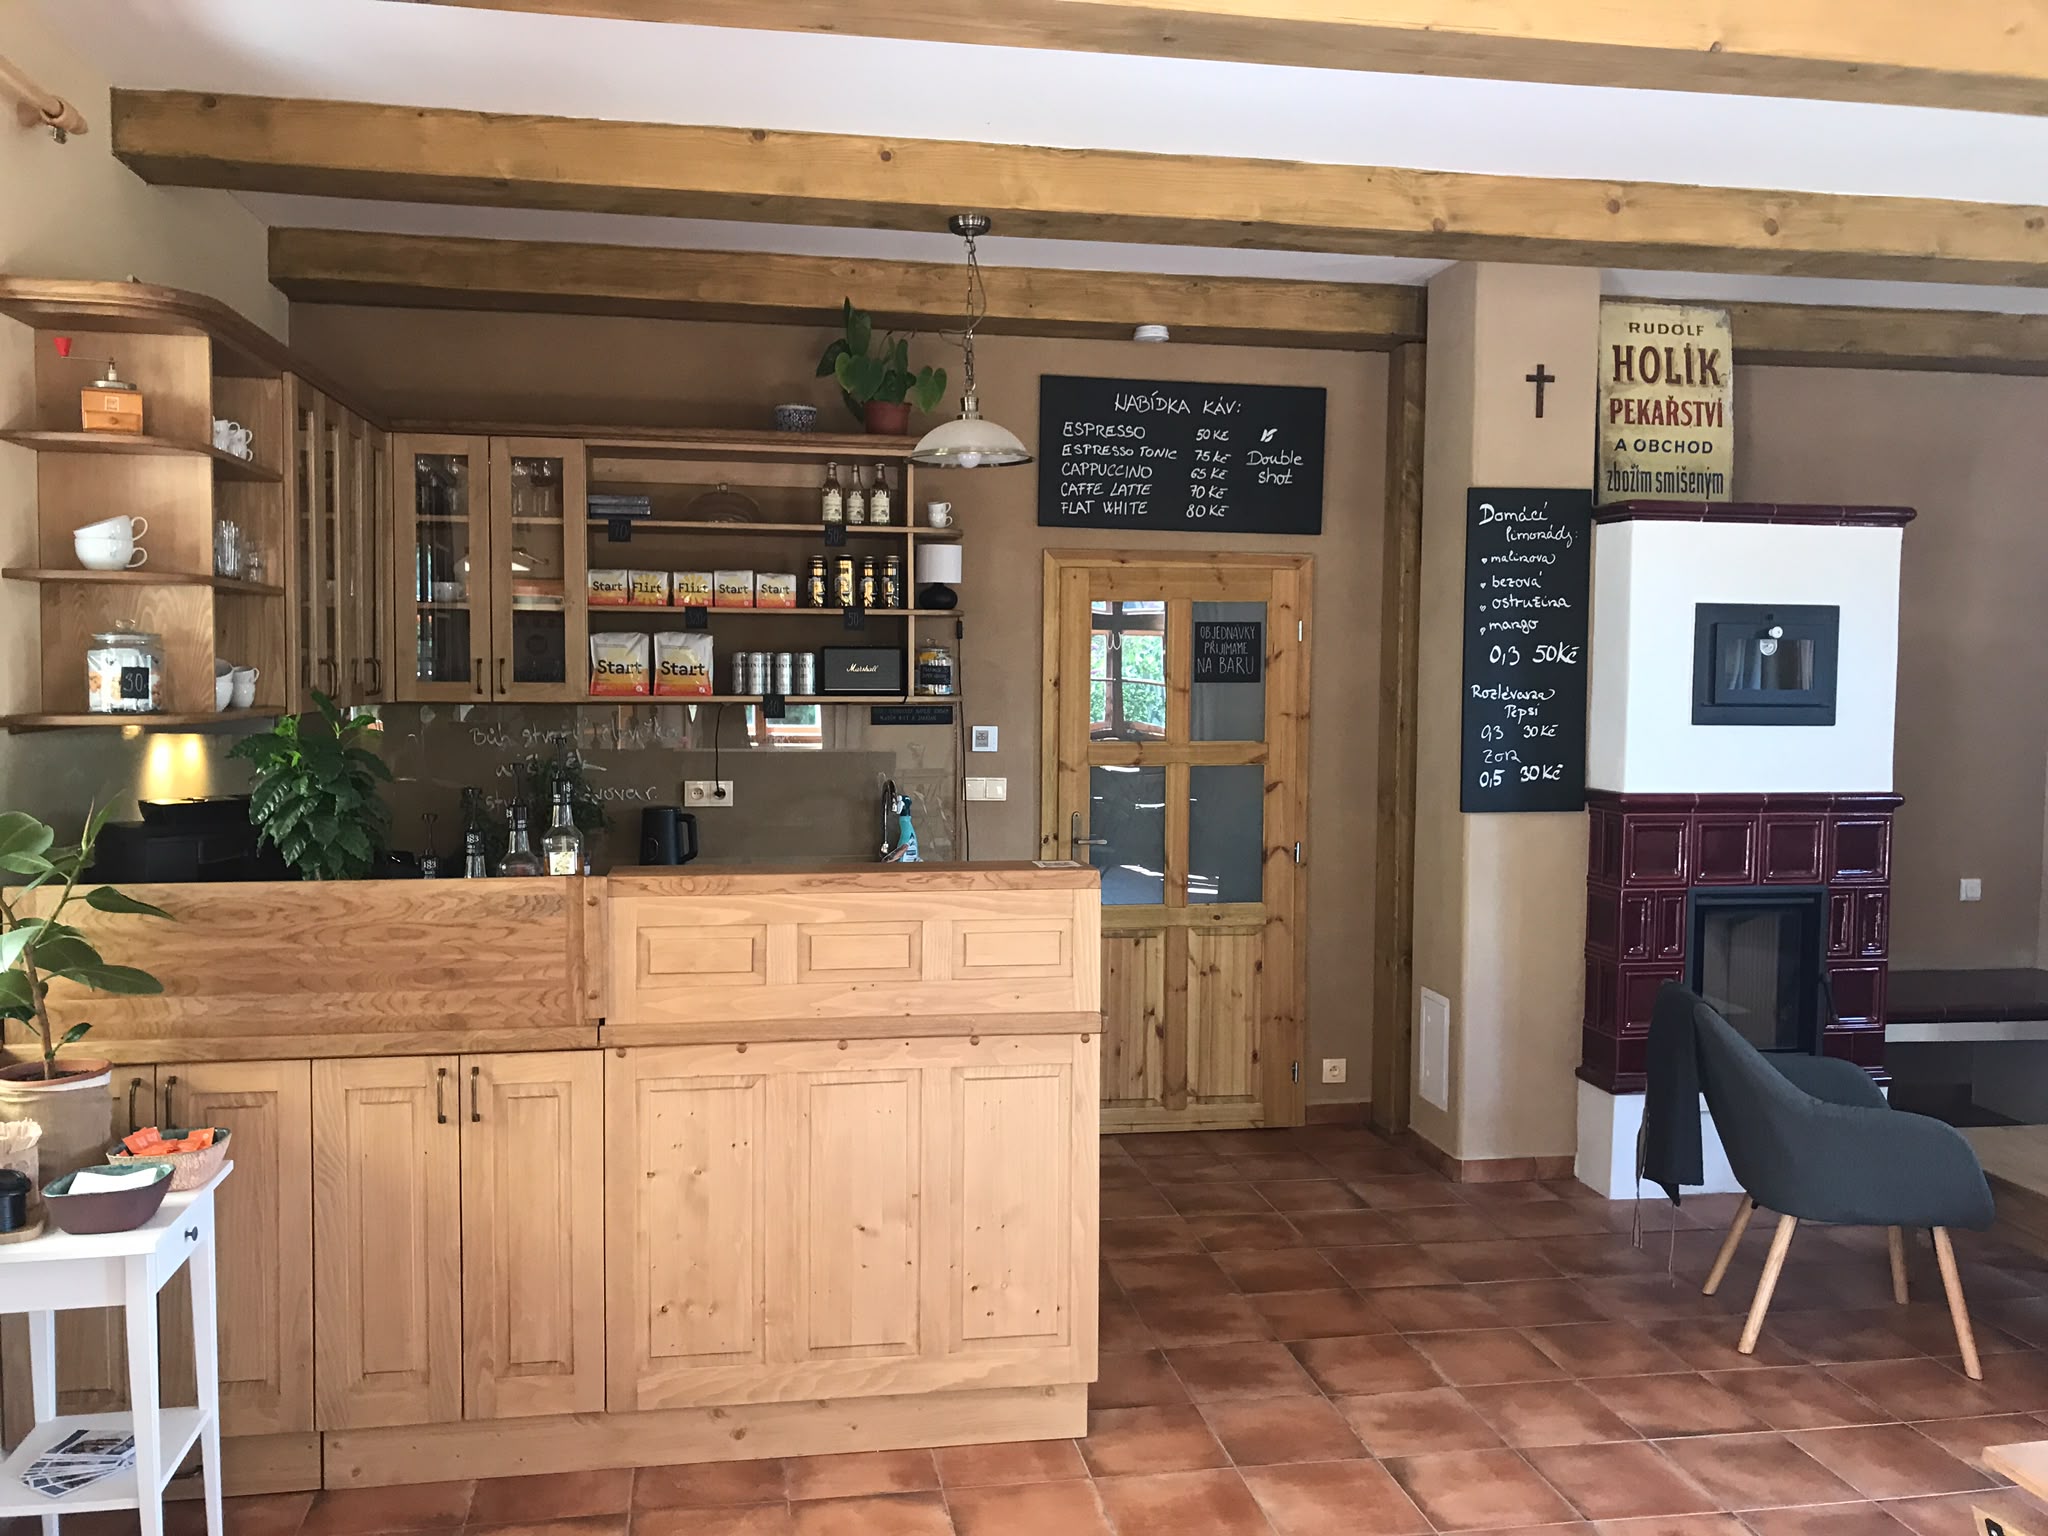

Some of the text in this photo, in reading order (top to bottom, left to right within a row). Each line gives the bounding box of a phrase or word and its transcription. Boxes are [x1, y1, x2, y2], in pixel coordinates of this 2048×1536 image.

[1629, 322, 1704, 336] RUDOLF
[1612, 343, 1721, 385] HOLÍK
[1114, 390, 1242, 416] NABÍDKA KÁV:
[1610, 395, 1723, 427] PEKAŘSTVÍ
[1062, 421, 1146, 440] ESPRESSO
[1195, 428, 1211, 442] 50
[1061, 443, 1134, 457] ESPRESSO
[1139, 445, 1178, 460] TONIC
[1194, 449, 1211, 462] 75
[1614, 438, 1713, 454] A OBCHOD
[1246, 449, 1304, 468] Double
[1061, 461, 1153, 479] CAPPUCCINO
[1190, 467, 1207, 480] 65
[1258, 468, 1293, 486] shot
[1607, 462, 1724, 500] zbožím smíšeným
[1060, 482, 1105, 497] CAFFE
[1109, 482, 1152, 497] LATTE
[1189, 484, 1206, 499] 70
[1060, 500, 1096, 515] FLAT
[1102, 500, 1148, 516] WHITE
[1185, 504, 1207, 519] 80
[1478, 501, 1548, 526] Domácí
[592, 580, 623, 592] Start
[633, 582, 662, 594] Flirt
[678, 582, 709, 594] Flirt
[1491, 570, 1543, 589] bezová
[719, 583, 749, 595] Start
[761, 583, 790, 595] Start
[1491, 593, 1572, 609] ostružina
[1488, 619, 1539, 635] mango
[1489, 644, 1521, 666] 0,3
[597, 659, 643, 675] Start
[660, 660, 706, 676] Start
[846, 662, 880, 673] Marshall
[1197, 656, 1254, 674] NA BARU
[1503, 703, 1541, 725] Pepsi
[1523, 724, 1539, 739] 30
[1479, 768, 1506, 788] 0,5
[1519, 765, 1540, 783] 30
